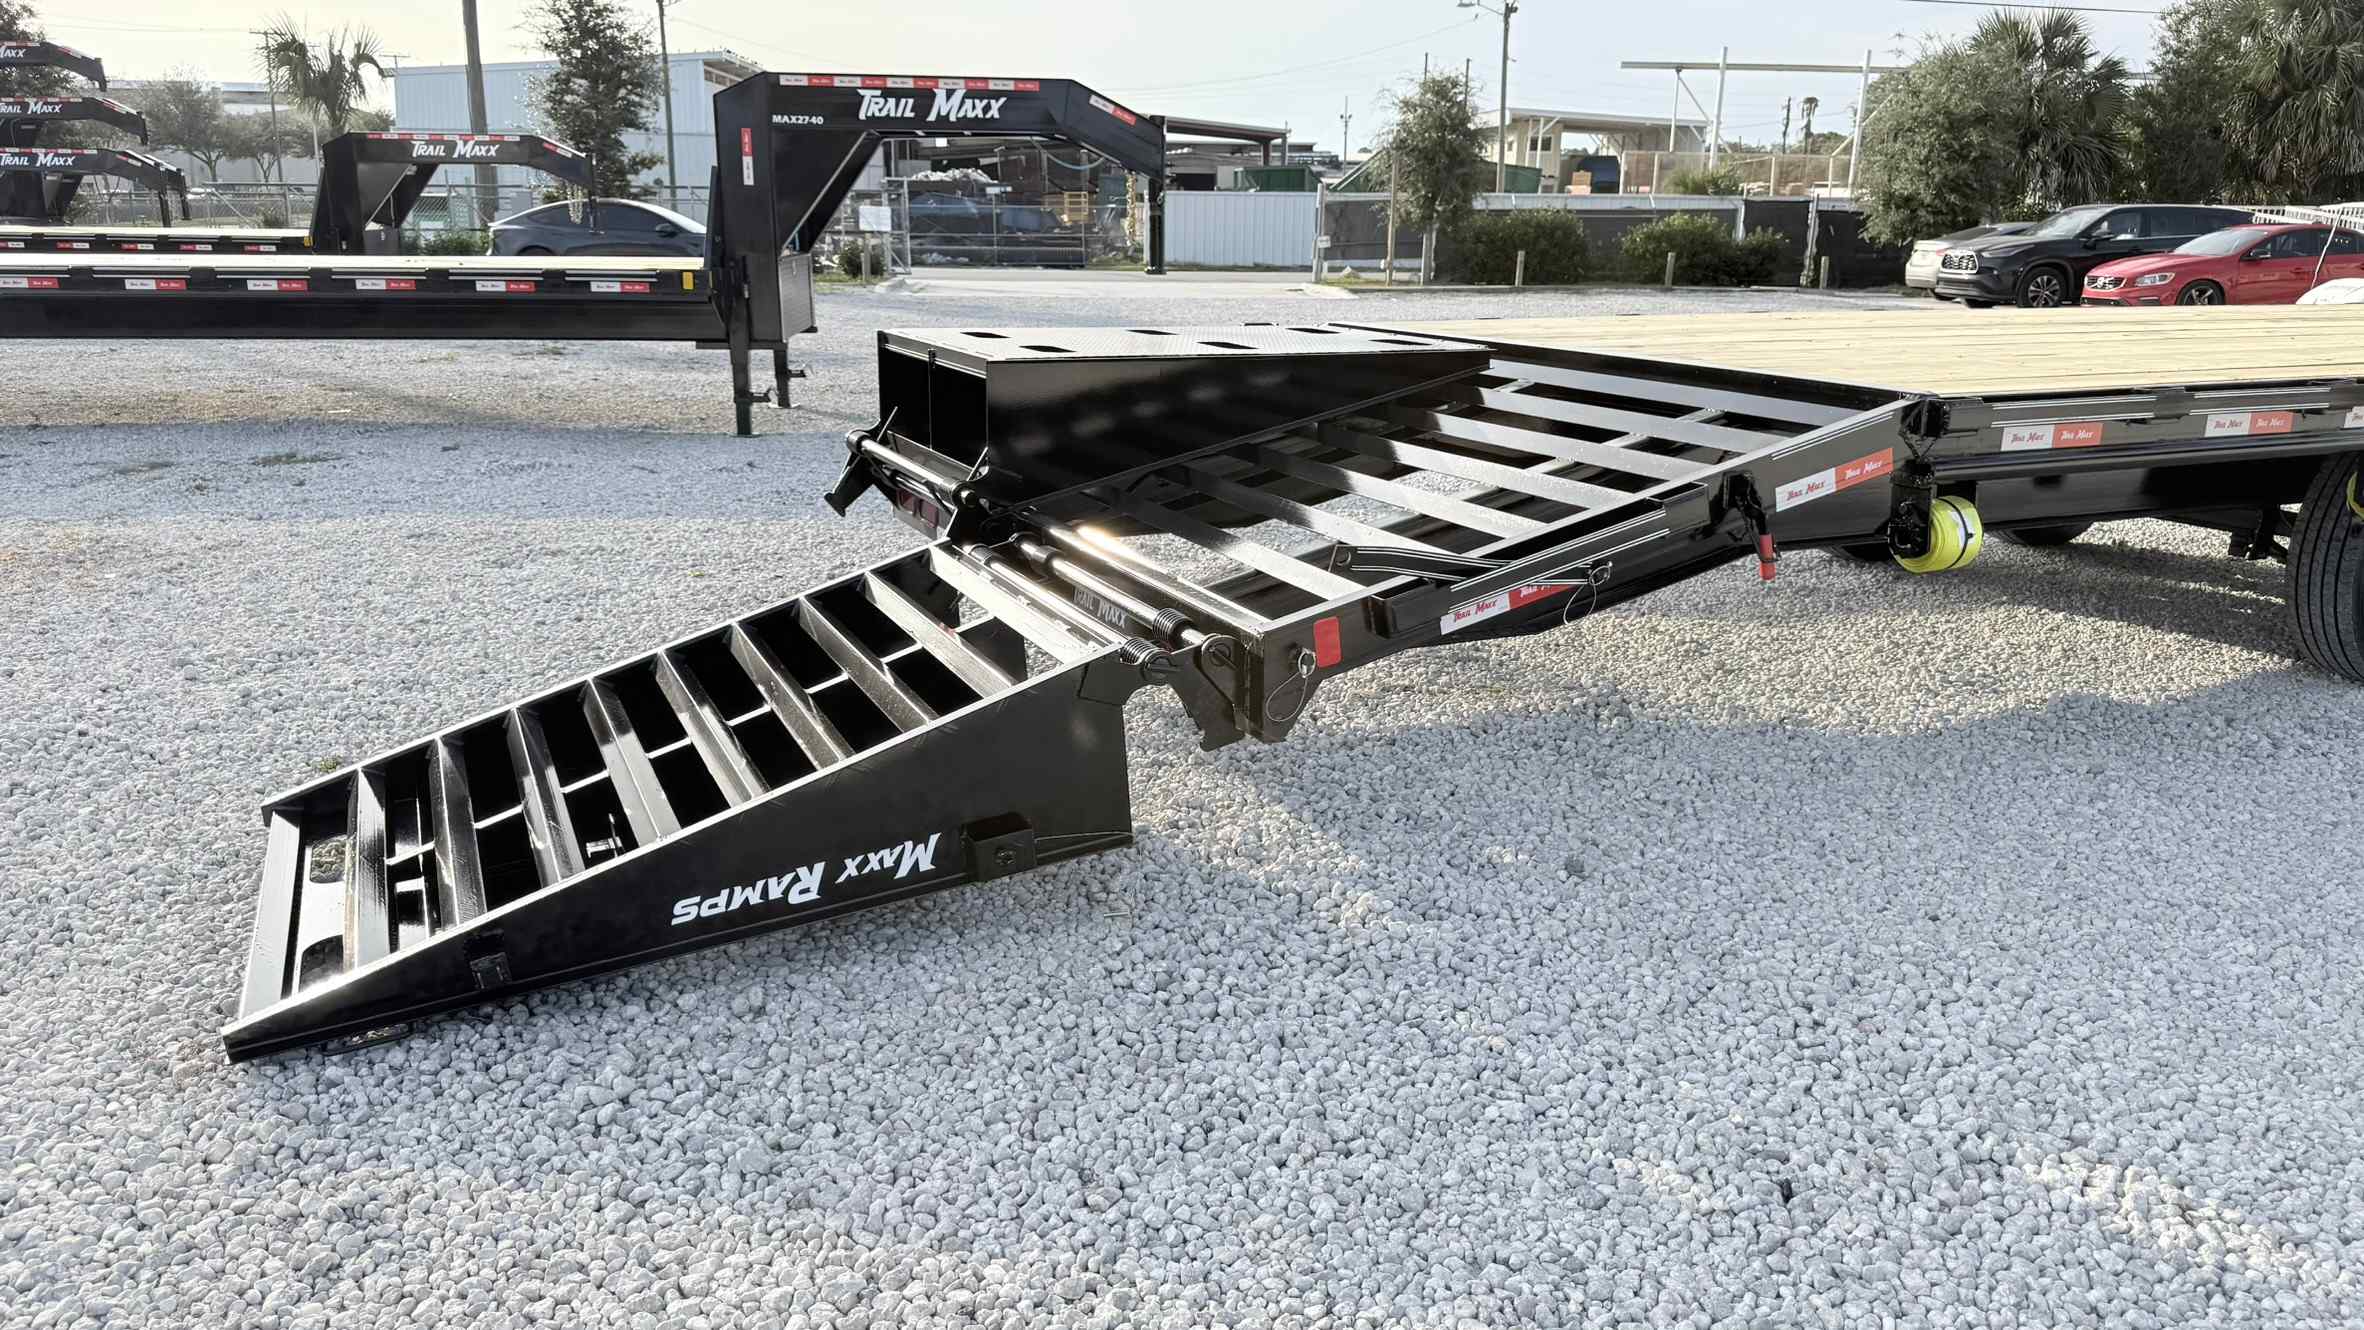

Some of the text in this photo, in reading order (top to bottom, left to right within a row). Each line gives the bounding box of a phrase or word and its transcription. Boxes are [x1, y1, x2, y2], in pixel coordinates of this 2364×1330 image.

[27, 101, 62, 115] MAXX
[857, 88, 1007, 122] TRAIL MAXX
[411, 139, 500, 158] TRAIL MAXX
[36, 152, 75, 167] MAXX
[671, 832, 942, 926] MAXX RAMPS
